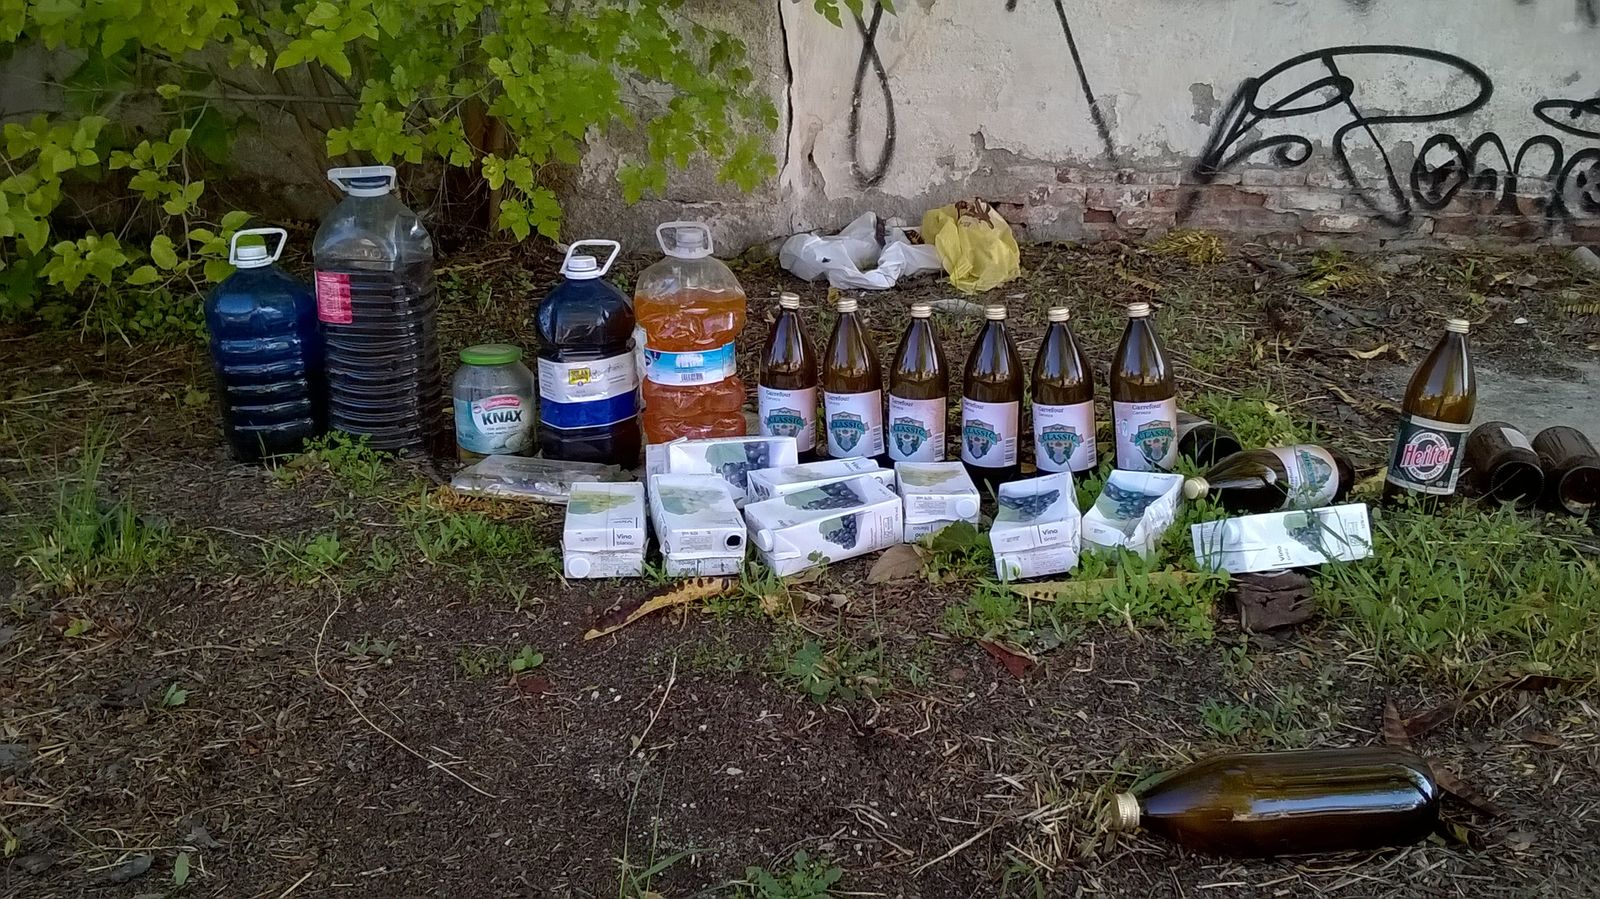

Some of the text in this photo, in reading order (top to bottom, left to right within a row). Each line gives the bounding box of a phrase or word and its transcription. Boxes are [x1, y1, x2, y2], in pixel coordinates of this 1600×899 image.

[481, 409, 523, 426] KNAX
[768, 414, 801, 426] CLASSIC
[1042, 432, 1076, 441] CLASSIC
[1139, 428, 1175, 440] CLASSIC
[1400, 444, 1454, 468] Heifer
[1041, 528, 1058, 536] Vino
